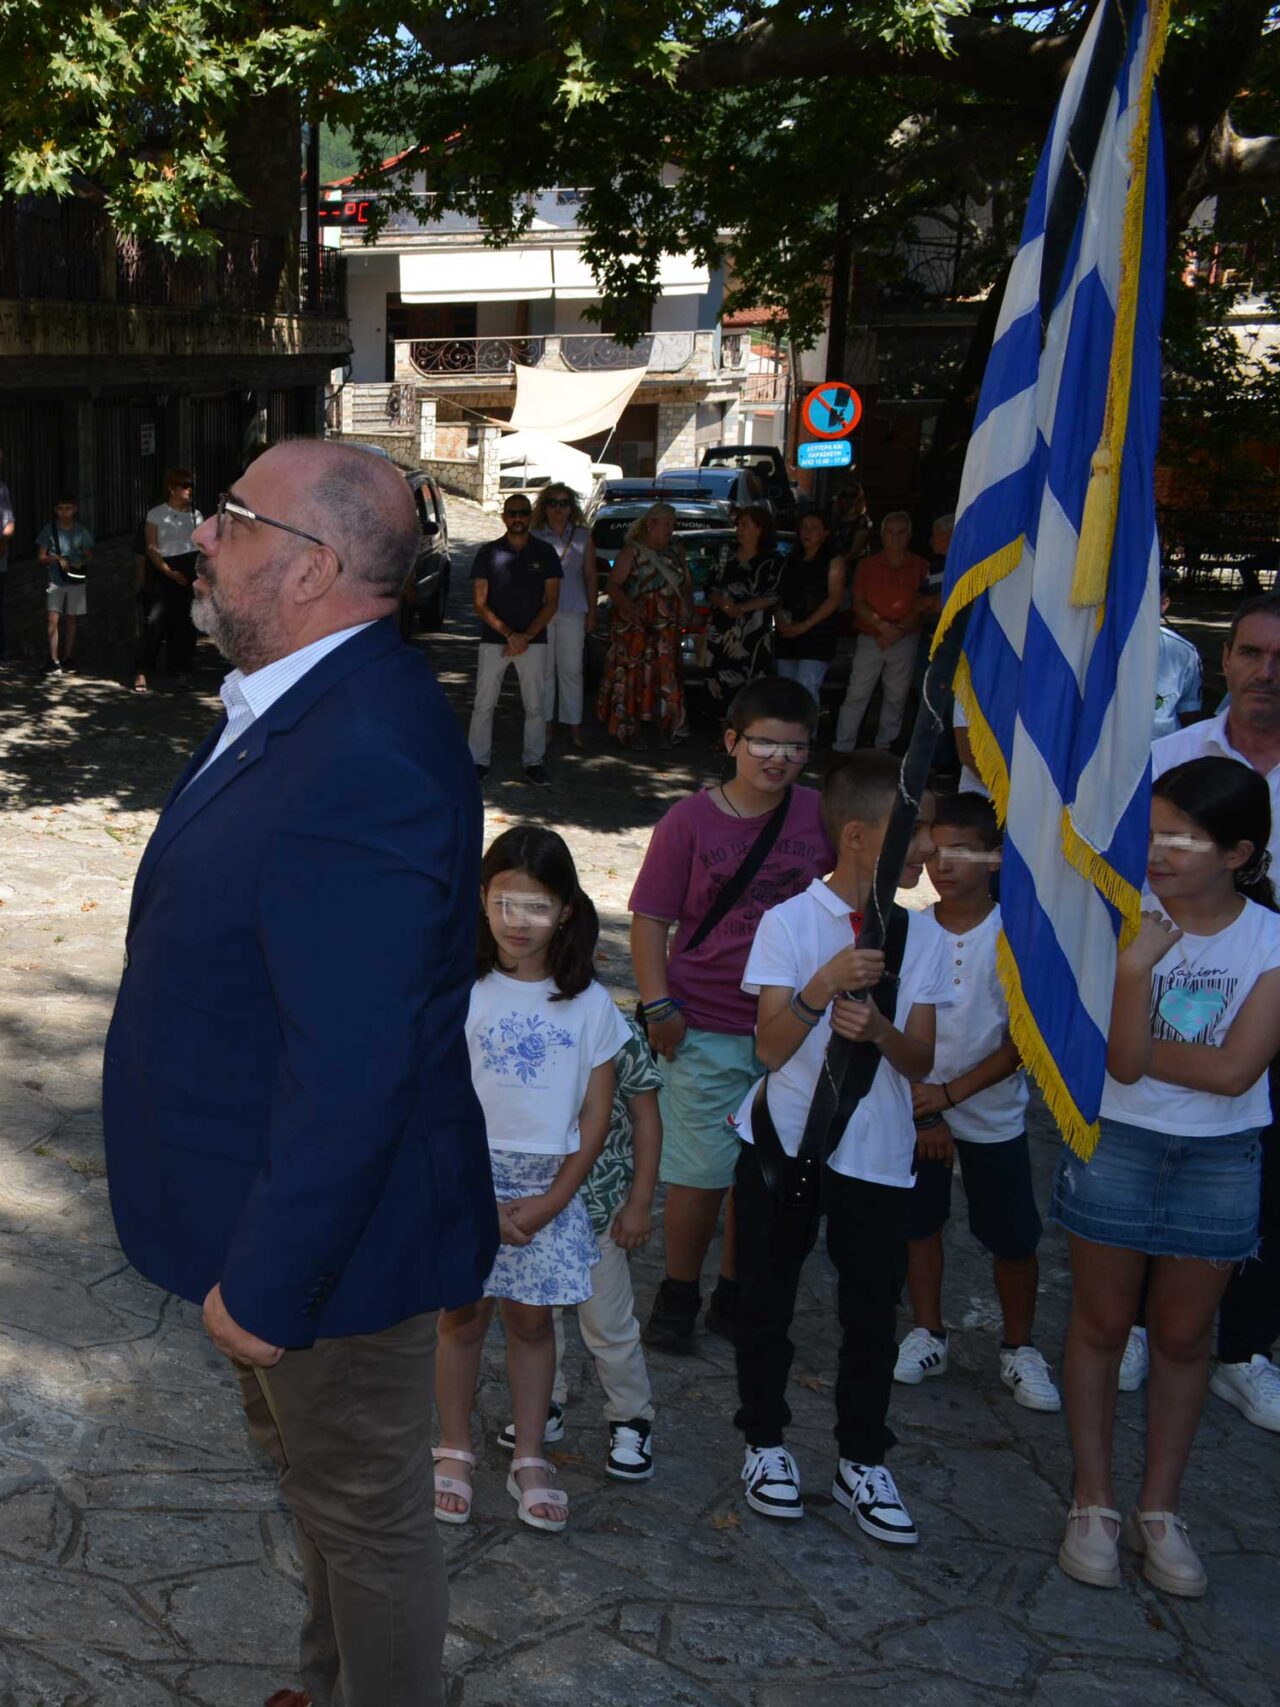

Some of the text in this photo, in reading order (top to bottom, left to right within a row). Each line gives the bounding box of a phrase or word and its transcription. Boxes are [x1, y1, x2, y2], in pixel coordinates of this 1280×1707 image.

[807, 444, 832, 452] ΔΕΥΤΕΡΑ
[700, 839, 816, 869] RIO DE NEIRO
